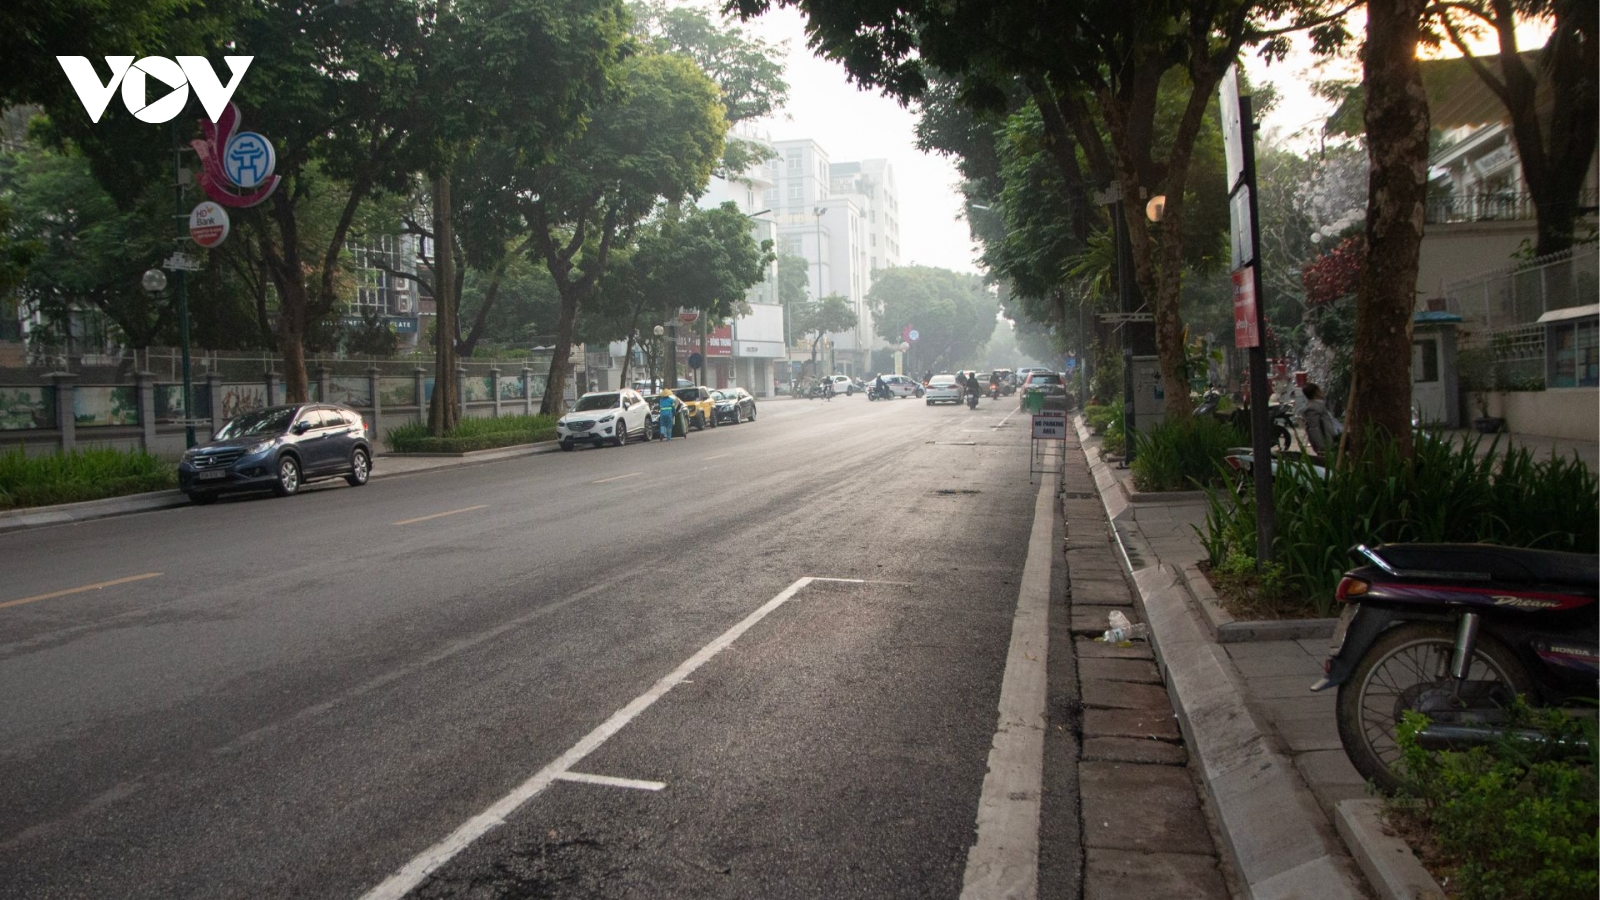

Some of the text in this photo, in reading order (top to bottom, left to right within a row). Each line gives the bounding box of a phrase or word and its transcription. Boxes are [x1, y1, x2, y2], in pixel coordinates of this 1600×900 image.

[196, 209, 208, 218] HD
[196, 217, 215, 226] Bank
[1491, 595, 1563, 608] Dream
[1550, 646, 1590, 656] HONDA
